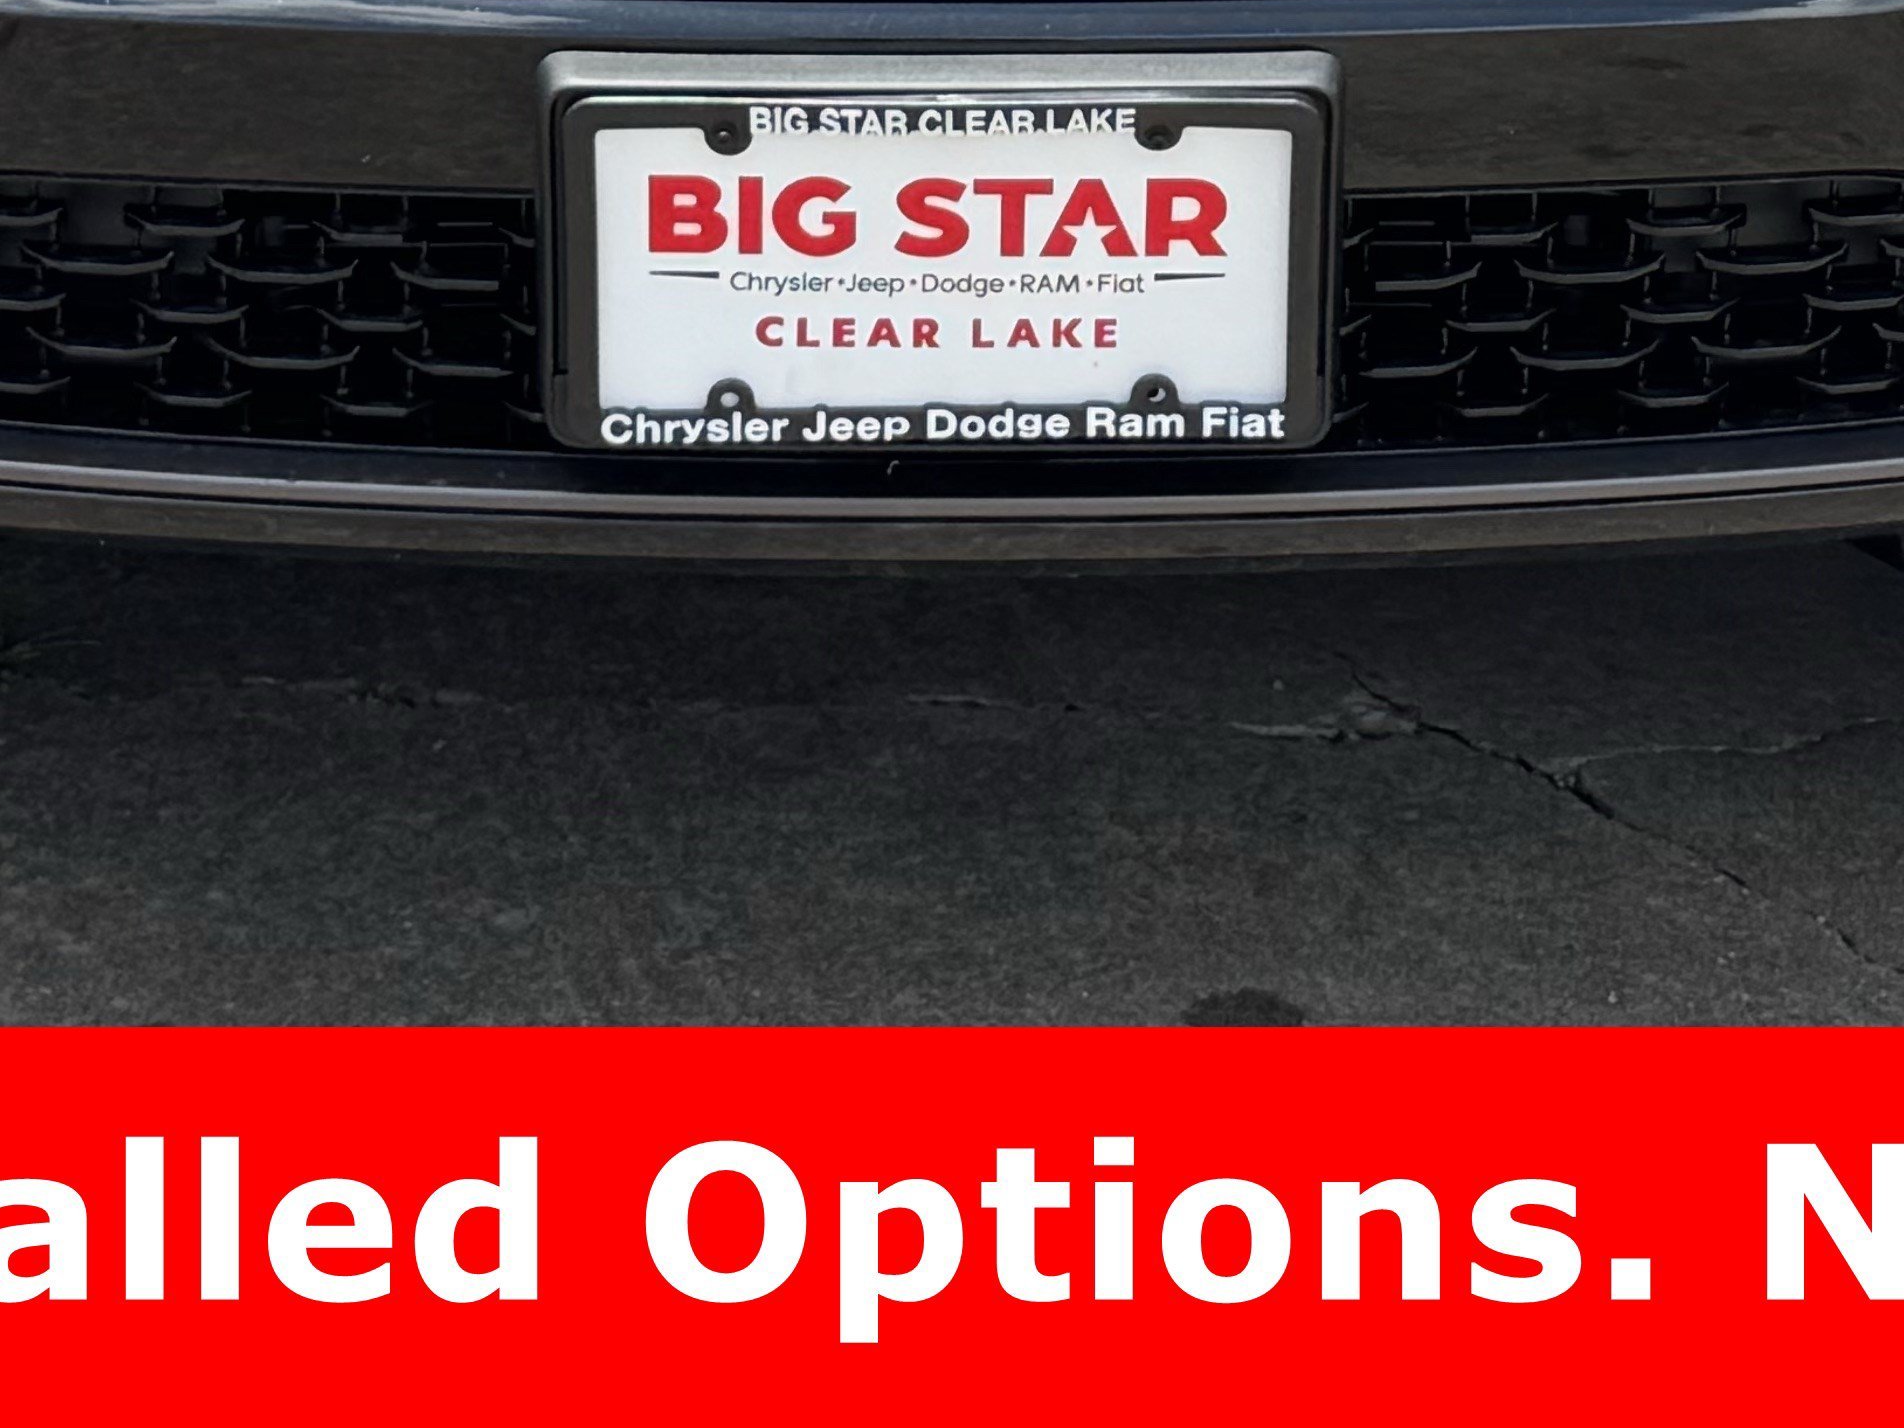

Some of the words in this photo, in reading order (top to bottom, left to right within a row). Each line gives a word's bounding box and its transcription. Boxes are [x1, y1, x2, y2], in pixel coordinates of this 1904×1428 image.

[749, 106, 809, 136] BIG
[818, 108, 908, 136] STAR
[918, 108, 1035, 137] CLEAR
[1045, 107, 1136, 135] LAKE
[648, 175, 857, 258] BIG
[895, 177, 1228, 259] STAR
[729, 271, 833, 298] Chrysler
[845, 273, 905, 298] Jeep
[921, 273, 1005, 298] Dodge
[1020, 273, 1080, 294] RAM
[1097, 273, 1145, 294] Fiat
[755, 316, 940, 348] CLEAR
[972, 318, 1118, 348] LAKE
[600, 410, 790, 444] Chrysler
[801, 410, 911, 442] Jeep
[926, 407, 1071, 440] Dodge
[1086, 406, 1186, 439] Ram
[1201, 405, 1286, 439] Fiat
